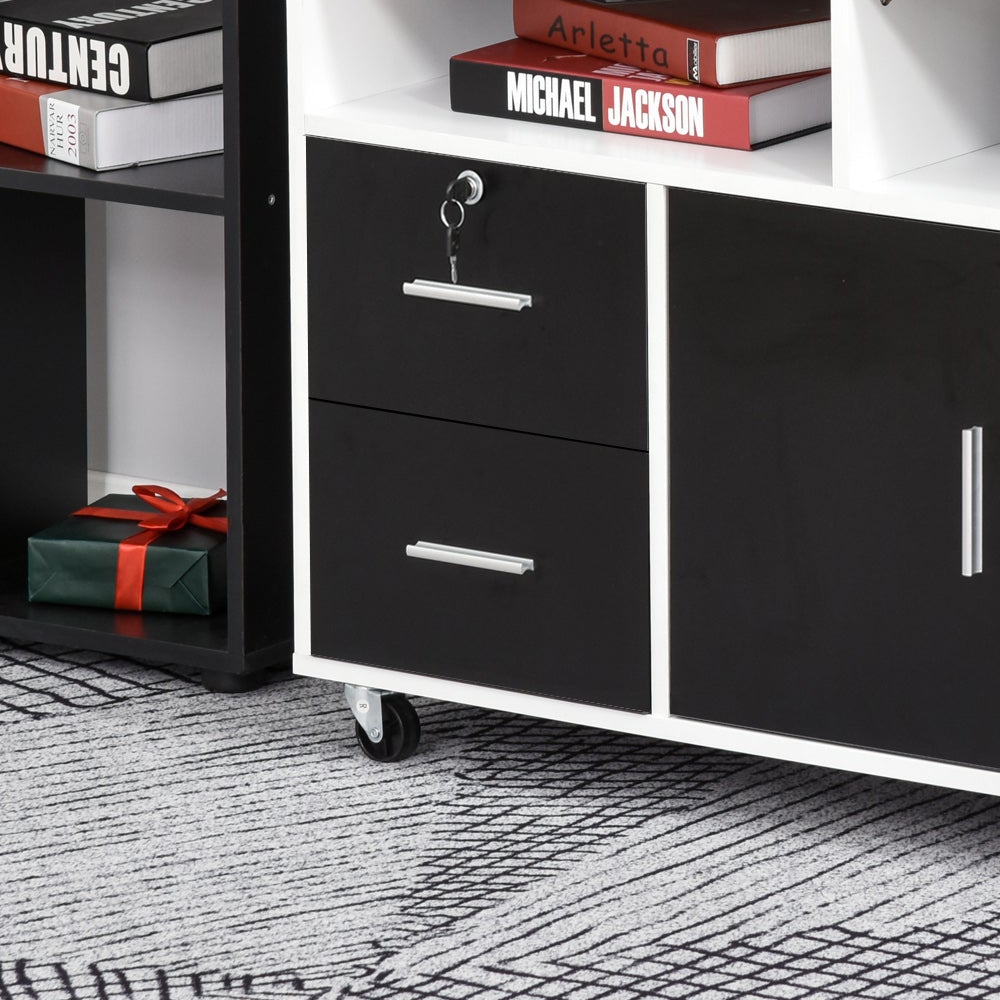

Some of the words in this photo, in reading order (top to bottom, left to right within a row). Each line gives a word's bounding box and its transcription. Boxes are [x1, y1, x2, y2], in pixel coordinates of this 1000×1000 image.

[0, 21, 131, 96] CENTUR
[548, 15, 670, 69] Arletta
[507, 71, 596, 123] MICHAEL
[607, 86, 704, 138] JACKSON
[68, 113, 77, 157] 2003
